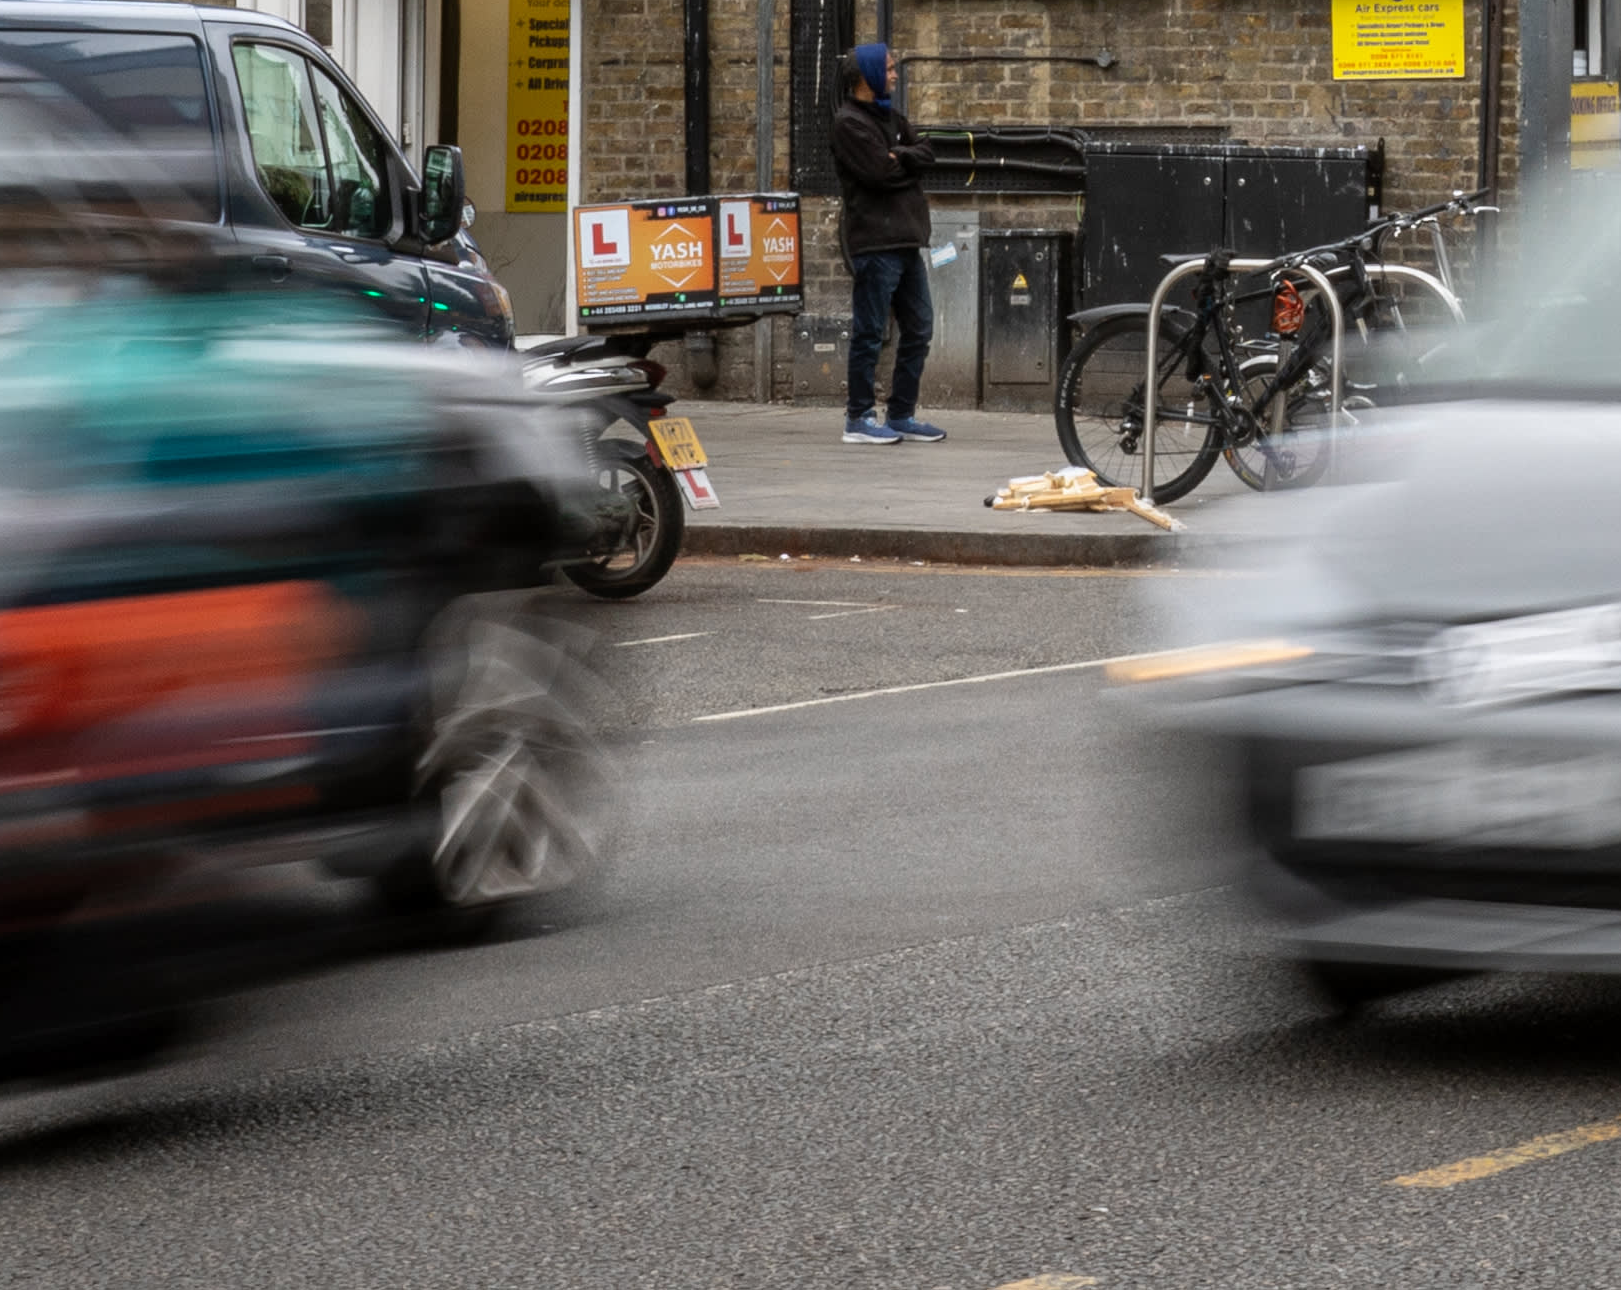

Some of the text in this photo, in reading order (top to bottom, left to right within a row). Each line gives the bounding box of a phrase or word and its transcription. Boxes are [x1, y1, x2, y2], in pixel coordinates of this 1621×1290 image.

[1355, 3, 1440, 13] Air Express cars
[592, 223, 617, 256] L
[727, 214, 743, 246] L
[650, 241, 703, 260] YASH
[763, 236, 794, 253] YASH
